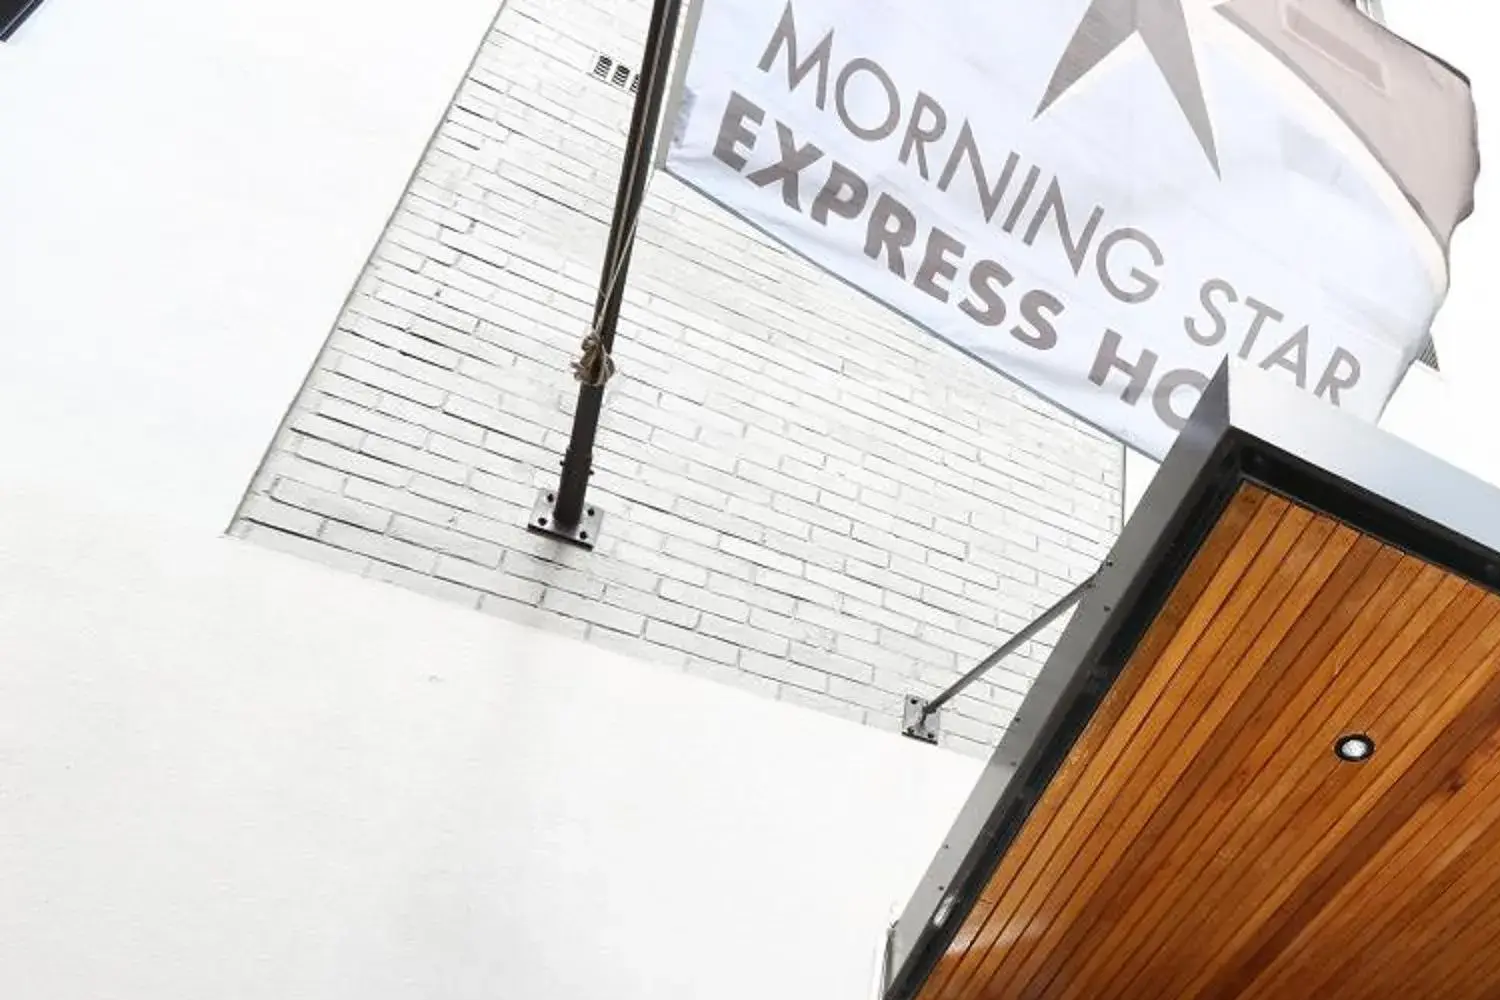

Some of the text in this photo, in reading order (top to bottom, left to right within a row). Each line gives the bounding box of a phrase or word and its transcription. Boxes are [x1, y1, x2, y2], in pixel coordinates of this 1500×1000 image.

[712, 90, 1066, 352] EXPRESS
[757, 0, 1362, 408] MORNING STAR
